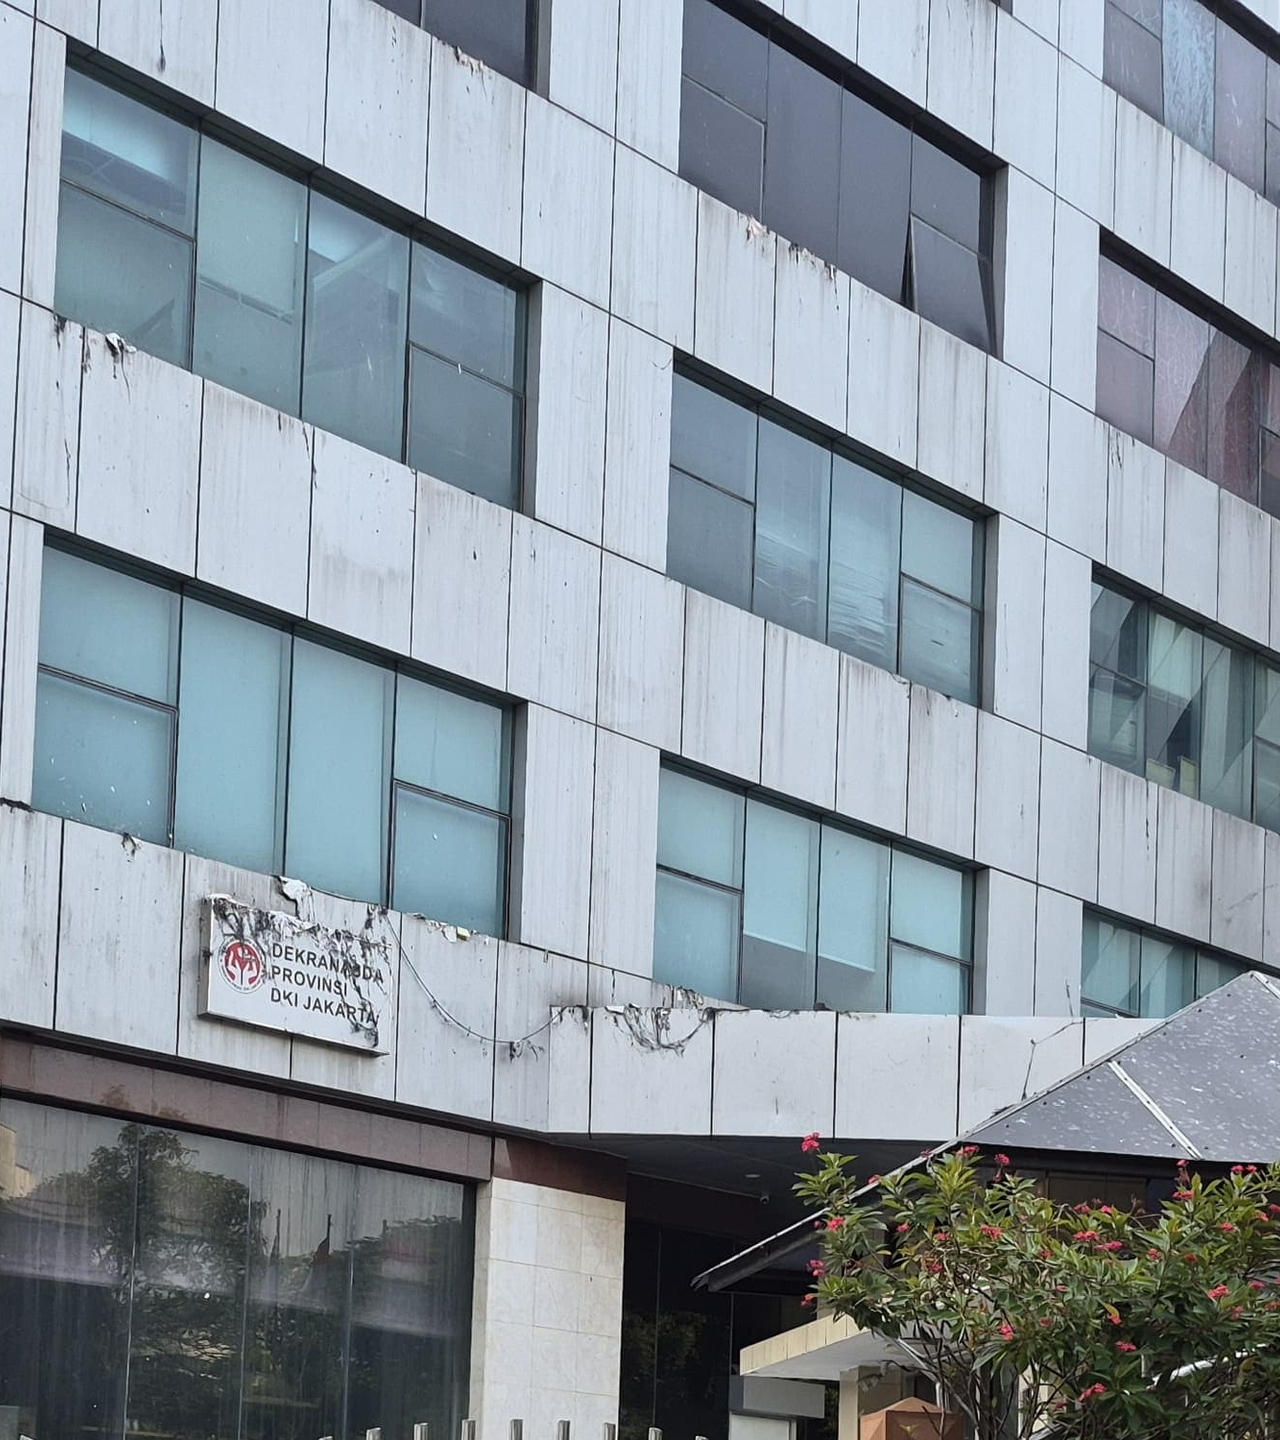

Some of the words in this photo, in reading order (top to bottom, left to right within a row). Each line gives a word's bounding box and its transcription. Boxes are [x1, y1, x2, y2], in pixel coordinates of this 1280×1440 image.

[272, 965, 347, 997] PROVINSI
[271, 987, 298, 1008] DKI
[303, 995, 377, 1025] JAKARTA
